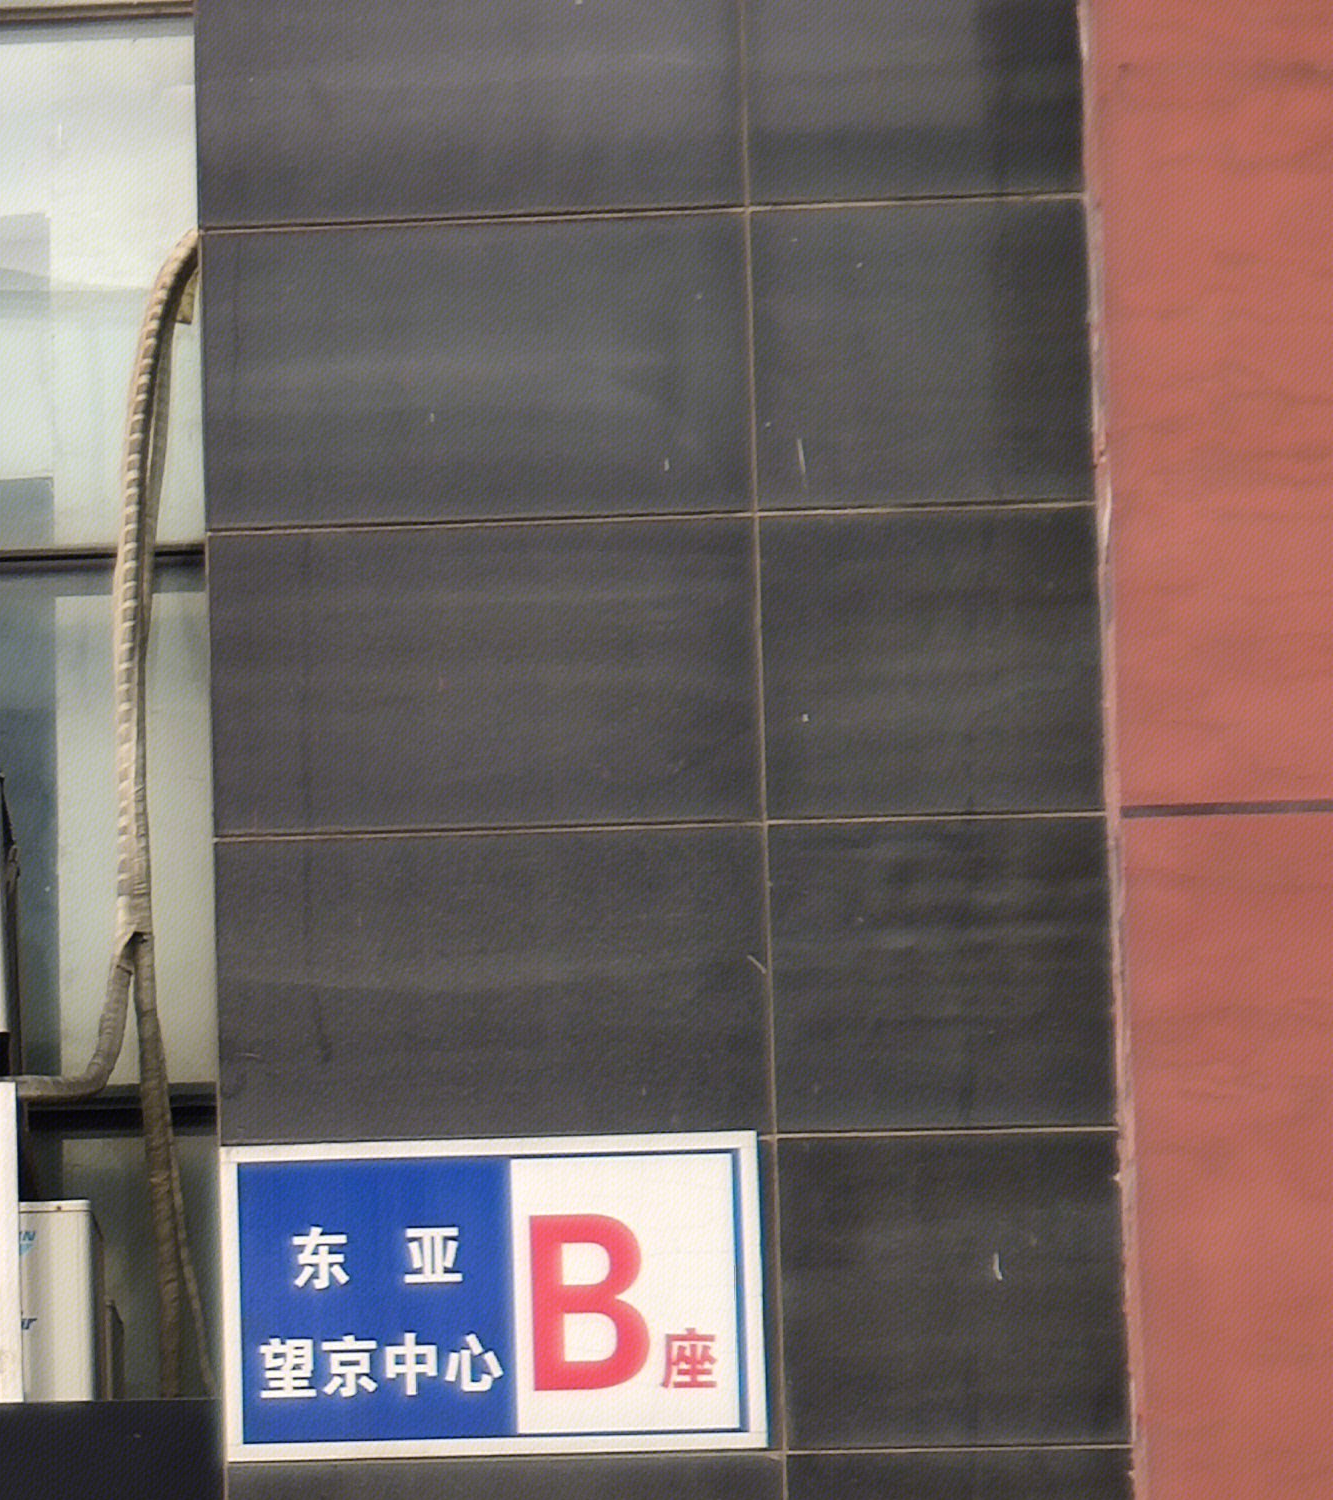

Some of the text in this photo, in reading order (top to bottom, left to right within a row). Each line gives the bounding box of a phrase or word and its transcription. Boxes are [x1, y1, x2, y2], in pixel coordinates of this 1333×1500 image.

[291, 1223, 464, 1291] 东亚
[257, 1331, 504, 1401] 望京中心
